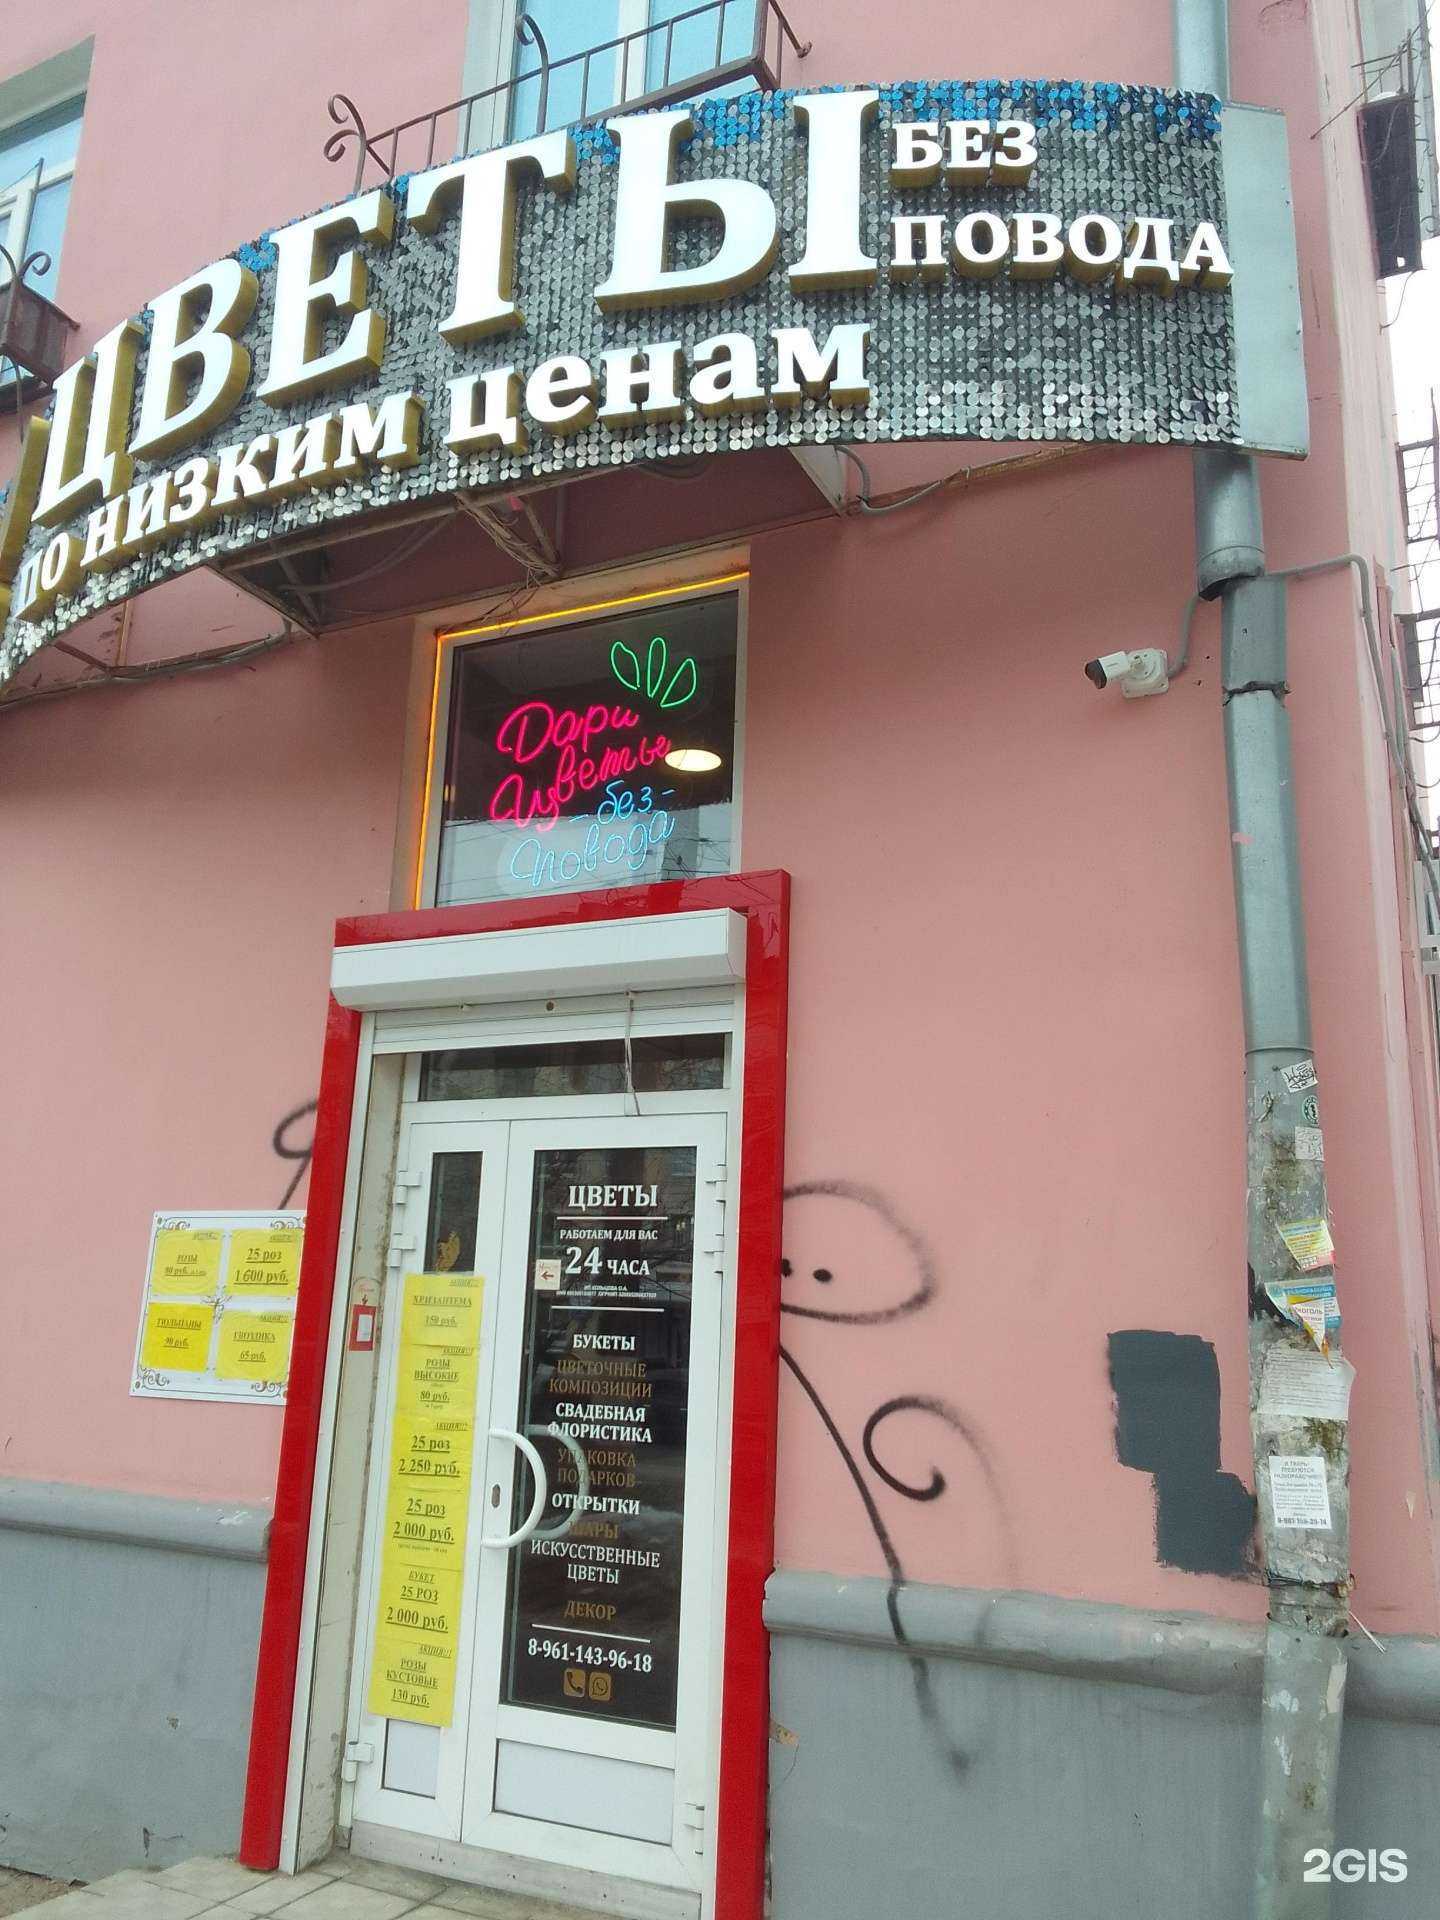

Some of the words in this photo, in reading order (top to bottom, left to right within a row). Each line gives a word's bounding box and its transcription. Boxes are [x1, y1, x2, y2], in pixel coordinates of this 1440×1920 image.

[891, 119, 1038, 173] БЕЗ
[891, 212, 1235, 279] ПОВОДА
[32, 89, 880, 525] ЦВЕТЫ
[80, 391, 422, 567] низким
[443, 323, 872, 447] ценам
[497, 701, 641, 764] Дари
[567, 1184, 658, 1211] ЦВЕТЫ
[559, 1229, 612, 1240] РАБОТАЕМ
[613, 1229, 636, 1241] ДЛЯ
[638, 1229, 658, 1241] ВАС
[246, 1247, 260, 1260] 25
[263, 1250, 282, 1262] роз
[564, 1246, 603, 1275] 24
[607, 1259, 651, 1276] ЧАСА
[266, 1269, 289, 1284] руб.
[573, 1333, 636, 1351] БУКЕТЫ
[556, 1359, 647, 1379] ЦВЕТОЧНЫЕ
[549, 1378, 653, 1399] КОМПОЗИЦИИ
[555, 1402, 647, 1423] СВАДЕБНАЯ
[547, 1420, 653, 1444] ФЛОРИСТИКА
[411, 1435, 426, 1449] 25
[429, 1439, 451, 1451] роз
[409, 1459, 432, 1473] 250
[434, 1461, 461, 1477] руб.
[558, 1448, 637, 1468] УПКОВКА
[406, 1497, 422, 1513] 25
[425, 1503, 446, 1517] роз
[552, 1492, 641, 1515] ОТКРЫТКИ
[404, 1522, 426, 1538] 000
[429, 1526, 455, 1543] руб.
[530, 1539, 661, 1568] ИСКУССТВЕННЫЕ
[566, 1563, 620, 1585] ЦВЕТЫ
[400, 1584, 414, 1598] 25
[416, 1587, 438, 1602] РОЗ
[397, 1607, 420, 1625] 000
[422, 1615, 449, 1631] руб.
[563, 1600, 617, 1621] ДЕКОР
[400, 1657, 428, 1672] РОЗЫ
[527, 1638, 653, 1673] 8-961-143-96-18
[386, 1668, 440, 1689] КУСТОВЫЕ
[392, 1688, 409, 1702] 130
[410, 1693, 431, 1706] руб.
